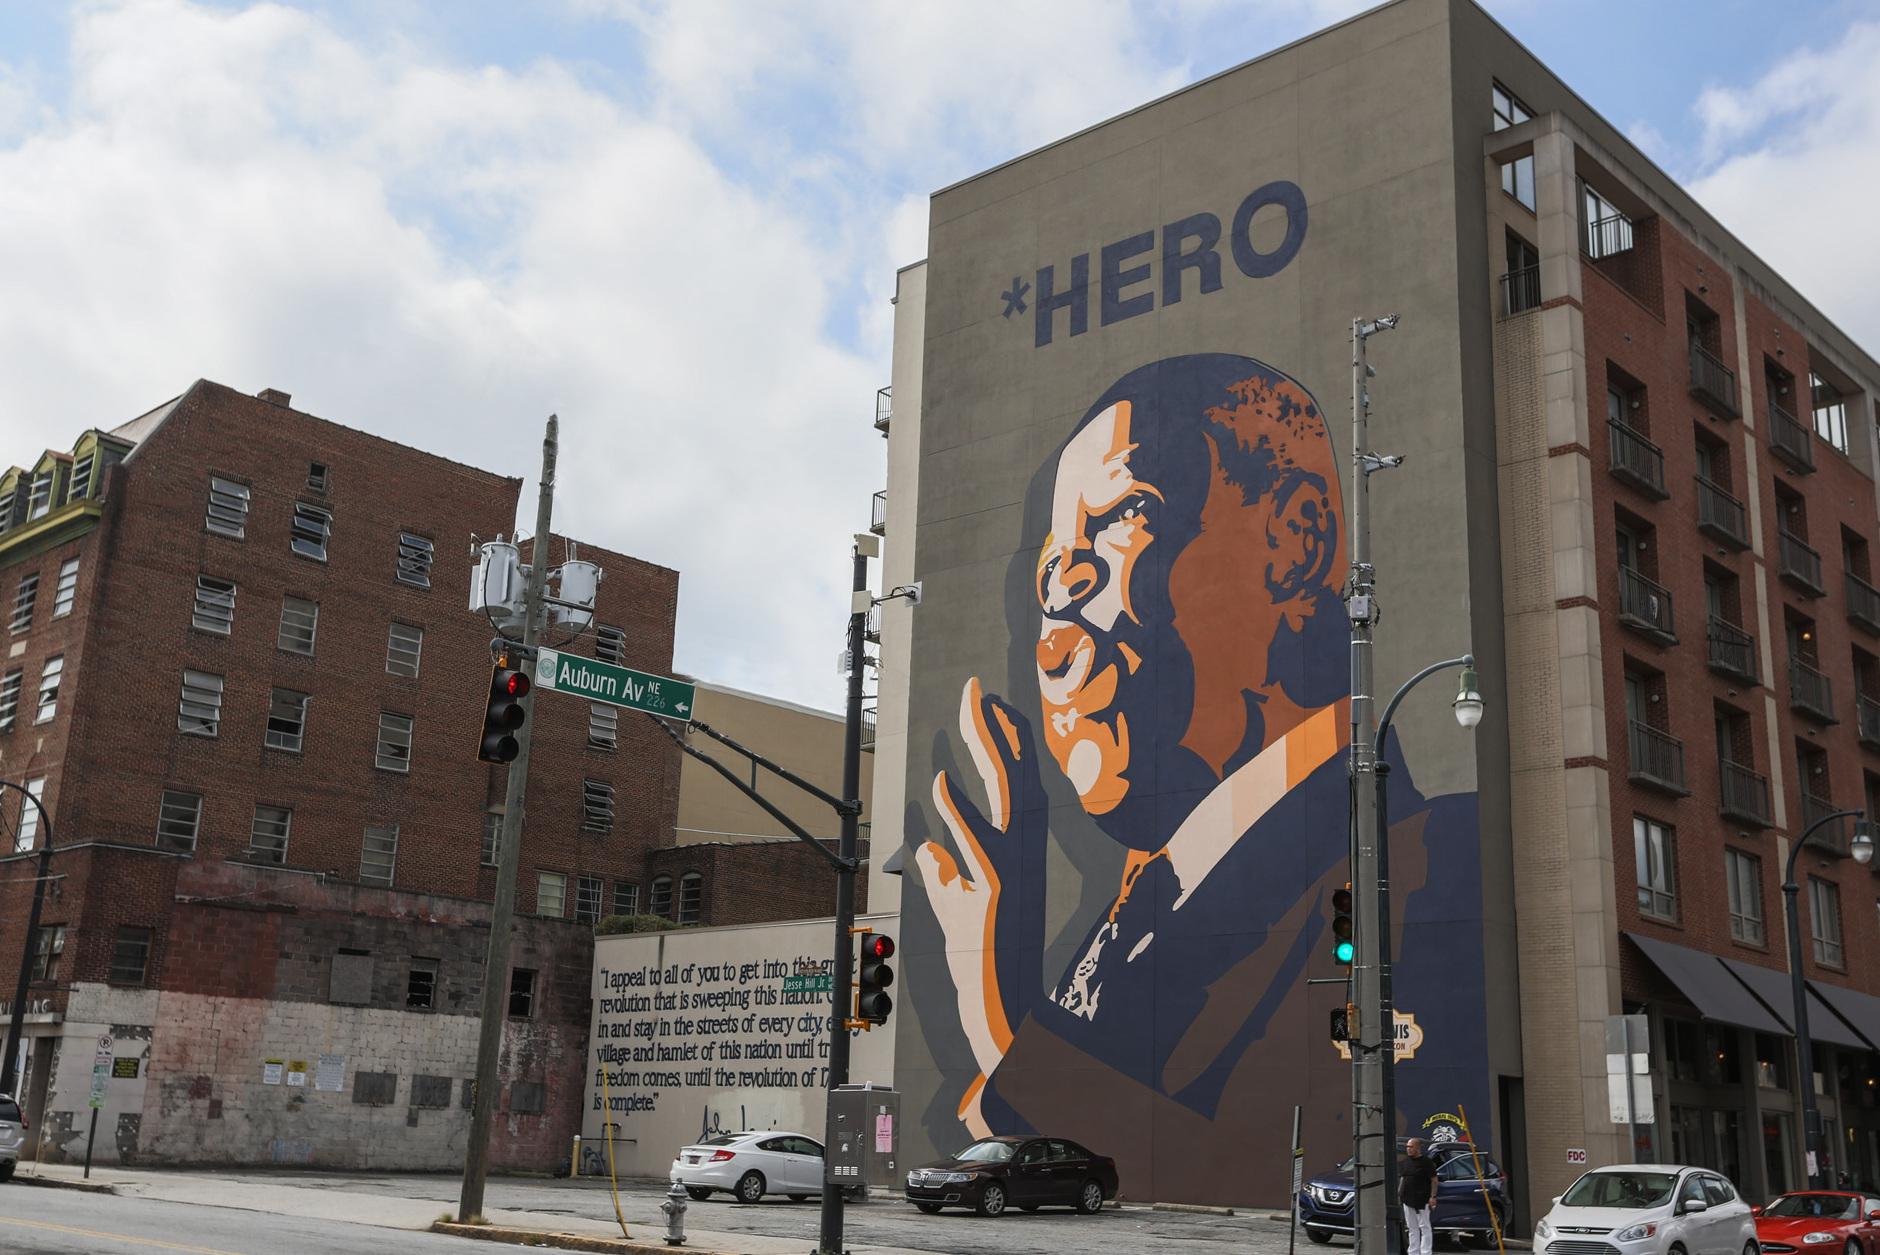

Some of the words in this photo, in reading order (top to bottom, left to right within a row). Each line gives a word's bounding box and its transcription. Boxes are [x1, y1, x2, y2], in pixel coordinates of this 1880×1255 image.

[558, 661, 616, 696] Auburn
[622, 677, 644, 702] Av
[648, 681, 661, 695] NE
[646, 693, 666, 709] 226
[610, 965, 646, 993] appeal
[649, 966, 661, 986] to
[664, 964, 678, 985] all
[681, 963, 695, 984] of
[696, 964, 720, 987] you
[723, 961, 736, 982] to
[739, 960, 760, 985] get
[763, 958, 788, 979] into
[792, 954, 817, 977] th
[784, 979, 802, 990] Jesse
[805, 977, 816, 989] Hill
[818, 977, 825, 988] Jr
[600, 993, 651, 1014] revolution
[654, 991, 677, 1011] that
[679, 990, 689, 1010] is
[691, 986, 751, 1012] sweeping
[754, 985, 777, 1006] this
[780, 989, 823, 1006] nation.
[598, 1019, 608, 1038] in
[610, 1018, 632, 1038] and
[634, 1018, 658, 1041] stay
[660, 1017, 671, 1036] in
[674, 1015, 694, 1036] the
[696, 1014, 738, 1035] streets
[741, 1013, 756, 1034] of
[759, 1016, 795, 1037] every
[797, 1012, 823, 1037] city,
[596, 1043, 631, 1066] village
[633, 1042, 655, 1063] and
[656, 1041, 699, 1062] hamlet
[701, 1041, 716, 1061] of
[719, 1040, 741, 1060] this
[744, 1039, 782, 1060] nation
[786, 1038, 814, 1059] until
[595, 1068, 640, 1087] freedom
[643, 1071, 682, 1088] comes,
[685, 1066, 711, 1087] until
[714, 1066, 736, 1087] the
[738, 1066, 798, 1088] revolution
[801, 1067, 817, 1087] of
[593, 1092, 602, 1111] is
[1568, 1151, 1585, 1161] FDC
